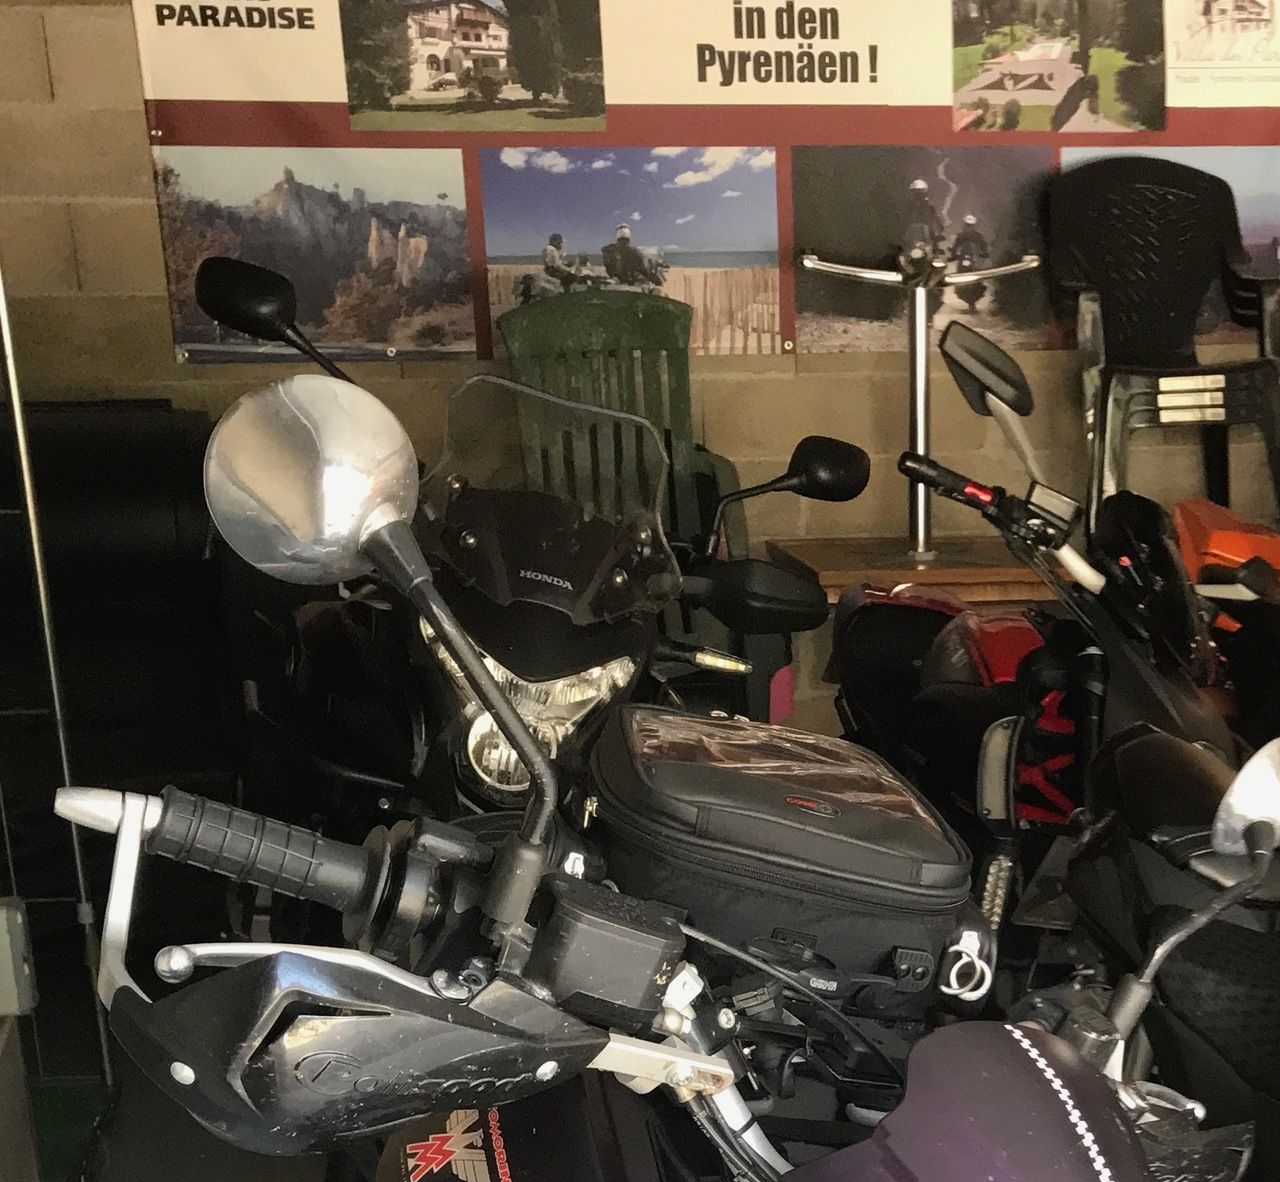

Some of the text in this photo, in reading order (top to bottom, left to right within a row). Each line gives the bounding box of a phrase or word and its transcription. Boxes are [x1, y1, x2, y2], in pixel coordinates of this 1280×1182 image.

[155, 4, 315, 30] PARADISE
[732, 0, 839, 40] in den
[696, 43, 878, 87] Pyrenäen !
[520, 569, 573, 590] HONDA
